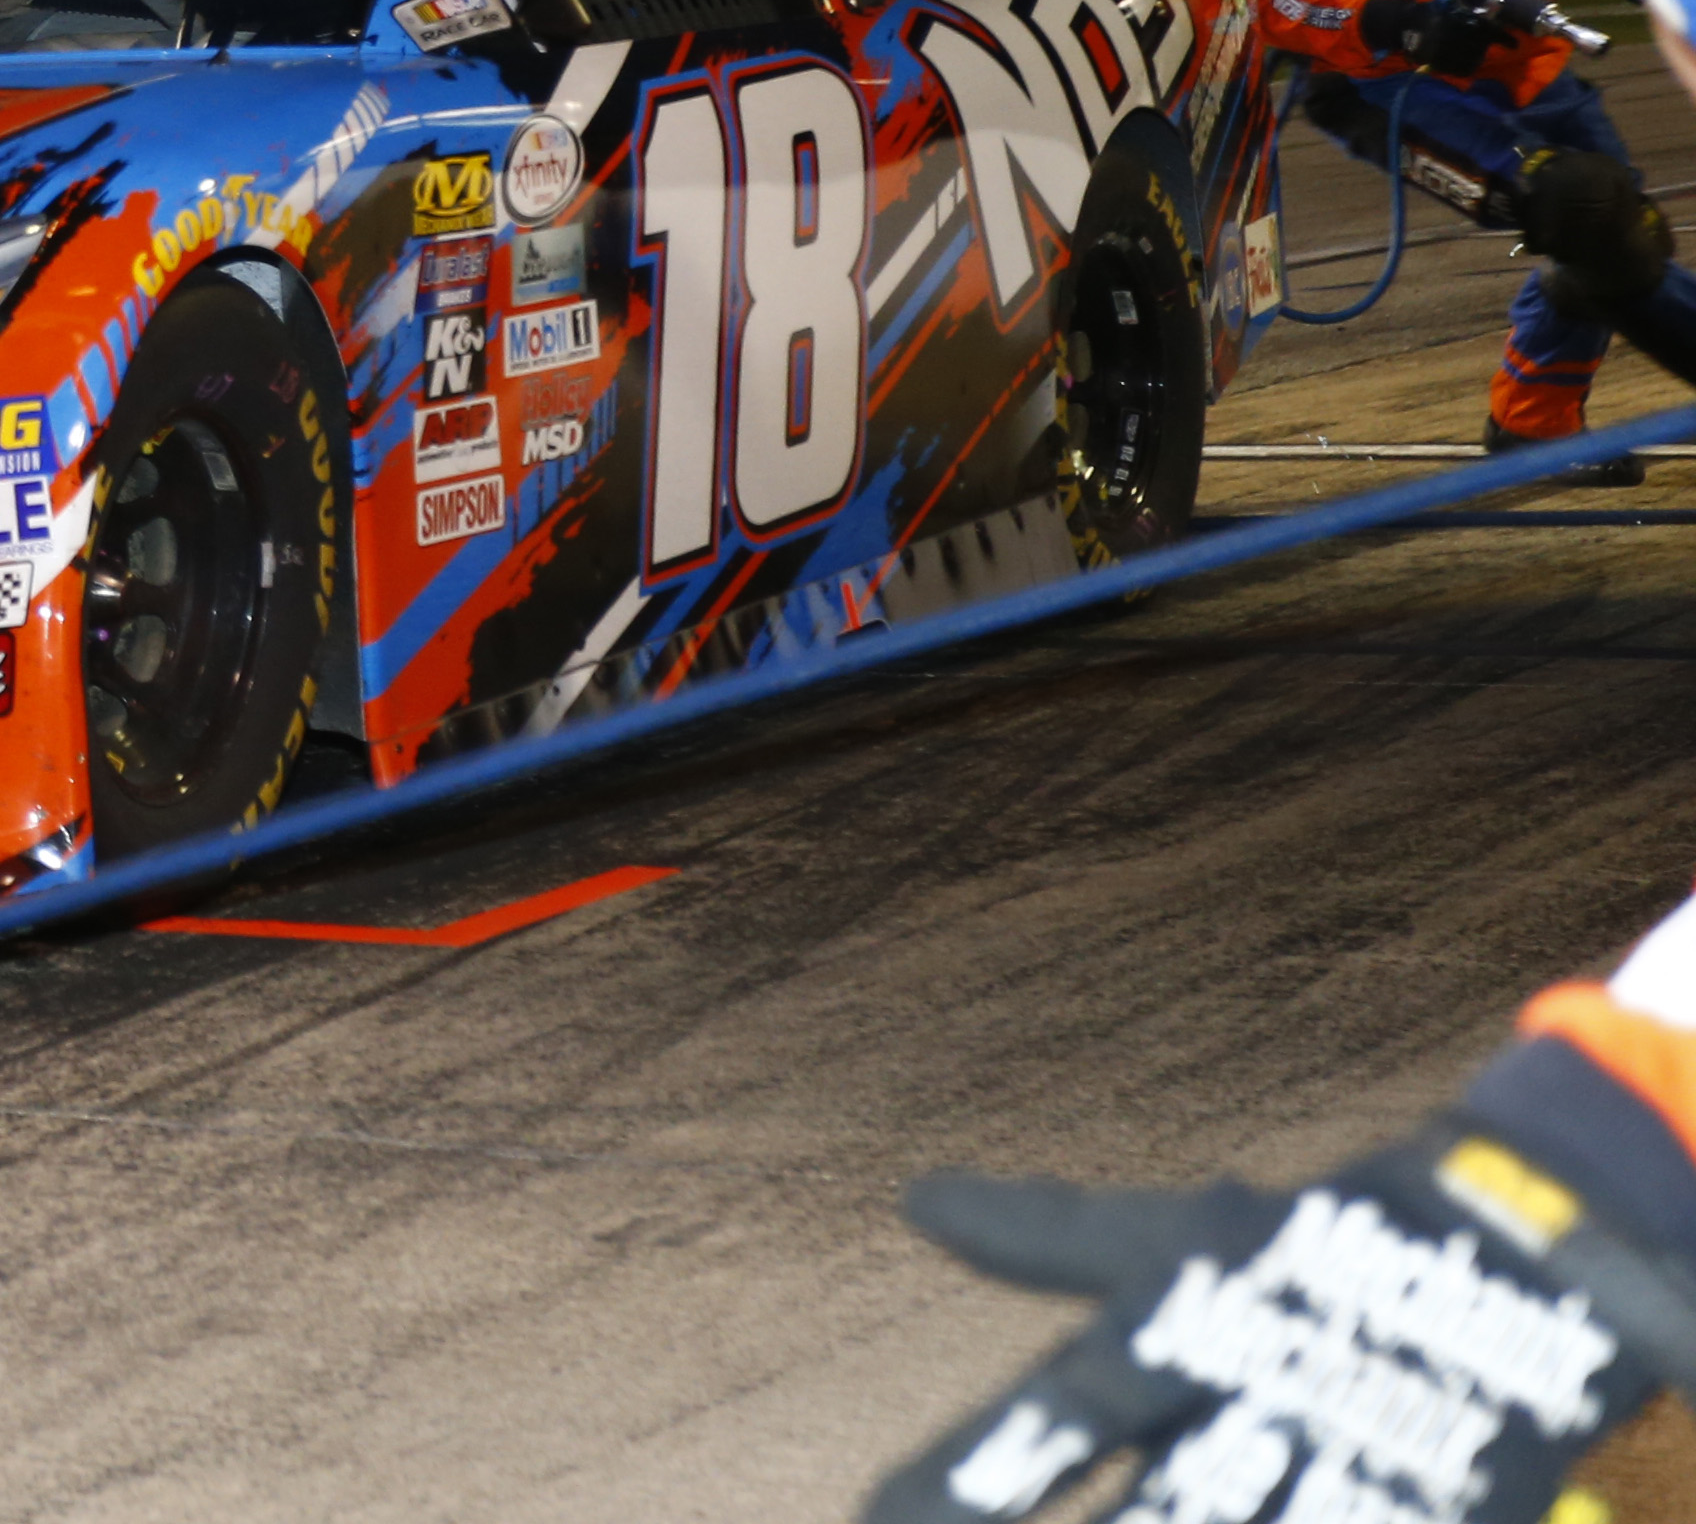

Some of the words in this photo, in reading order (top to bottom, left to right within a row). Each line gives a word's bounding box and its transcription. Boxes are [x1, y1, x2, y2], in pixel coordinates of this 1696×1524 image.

[420, 19, 465, 43] RACE
[469, 11, 501, 29] CAR
[513, 154, 569, 198] xfinity
[133, 188, 313, 298] GOODYEAR
[510, 311, 567, 363] Mobil
[641, 66, 868, 568] 18
[419, 403, 495, 449] ARP
[522, 420, 583, 466] MSD
[422, 481, 500, 539] SIMPSON
